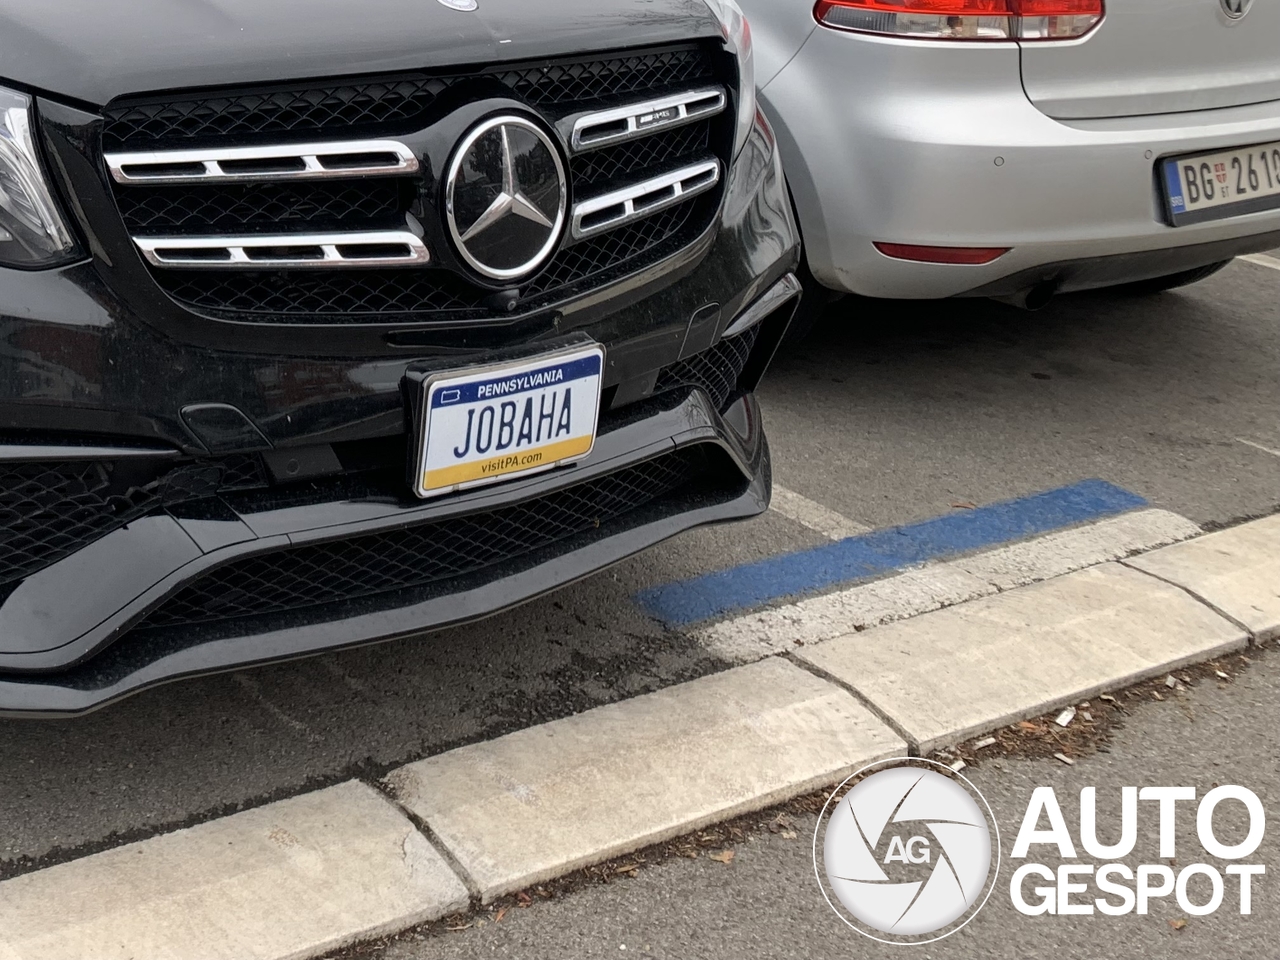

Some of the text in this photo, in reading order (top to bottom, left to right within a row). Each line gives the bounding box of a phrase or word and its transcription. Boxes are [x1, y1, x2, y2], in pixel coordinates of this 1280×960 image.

[1183, 162, 1215, 204] BG
[477, 368, 563, 398] PENNSYLVANIA
[453, 387, 572, 459] JOBAHA
[481, 451, 542, 473] visitPA.com
